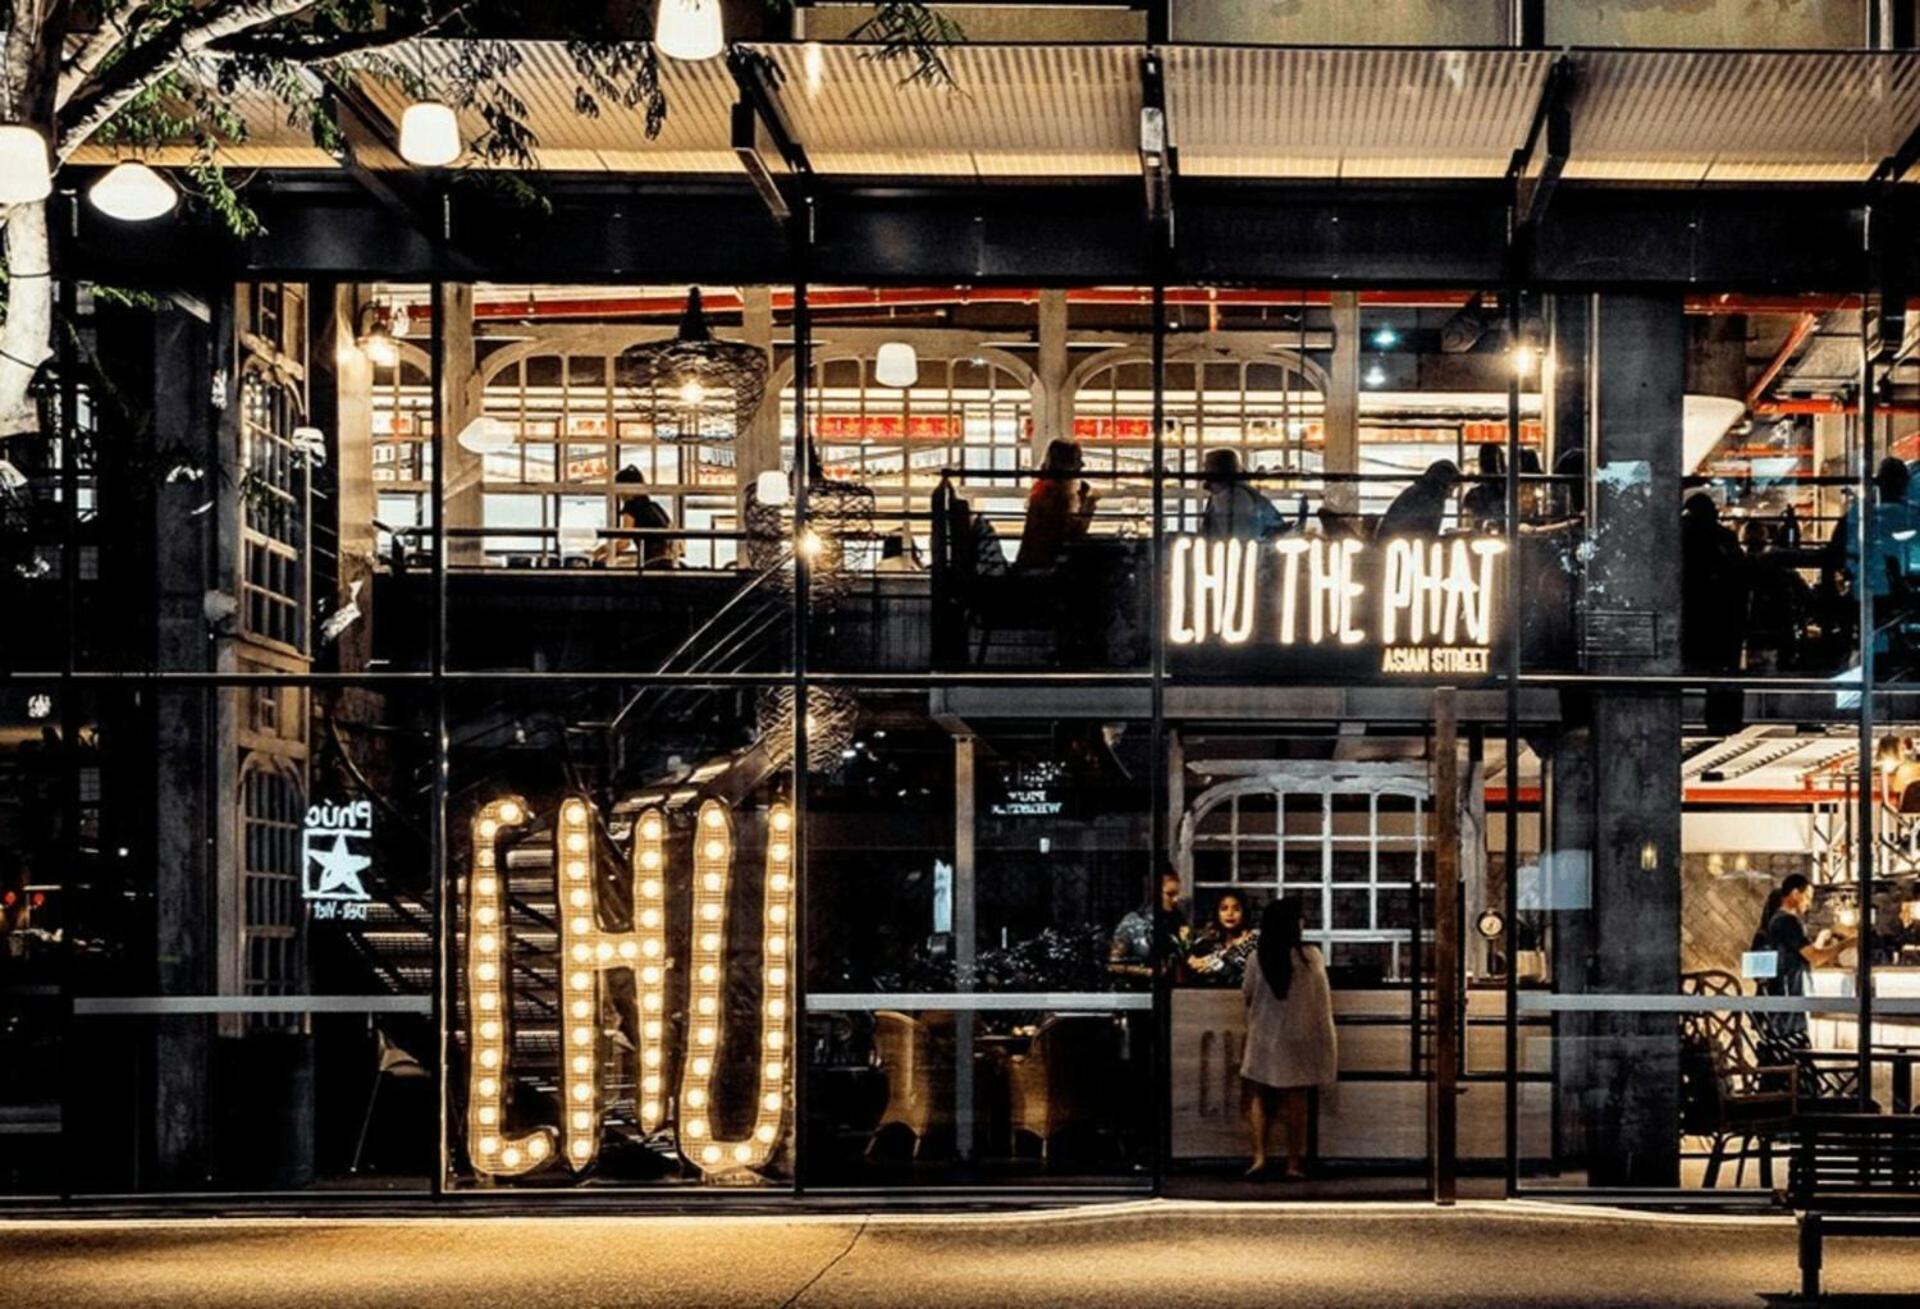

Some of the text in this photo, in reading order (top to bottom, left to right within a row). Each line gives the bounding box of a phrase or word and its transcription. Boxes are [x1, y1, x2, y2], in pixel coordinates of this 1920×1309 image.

[1169, 537, 1507, 645] CHU THE PHAT
[1382, 647, 1490, 673] ASIAN STREET
[468, 797, 795, 1176] CHU
